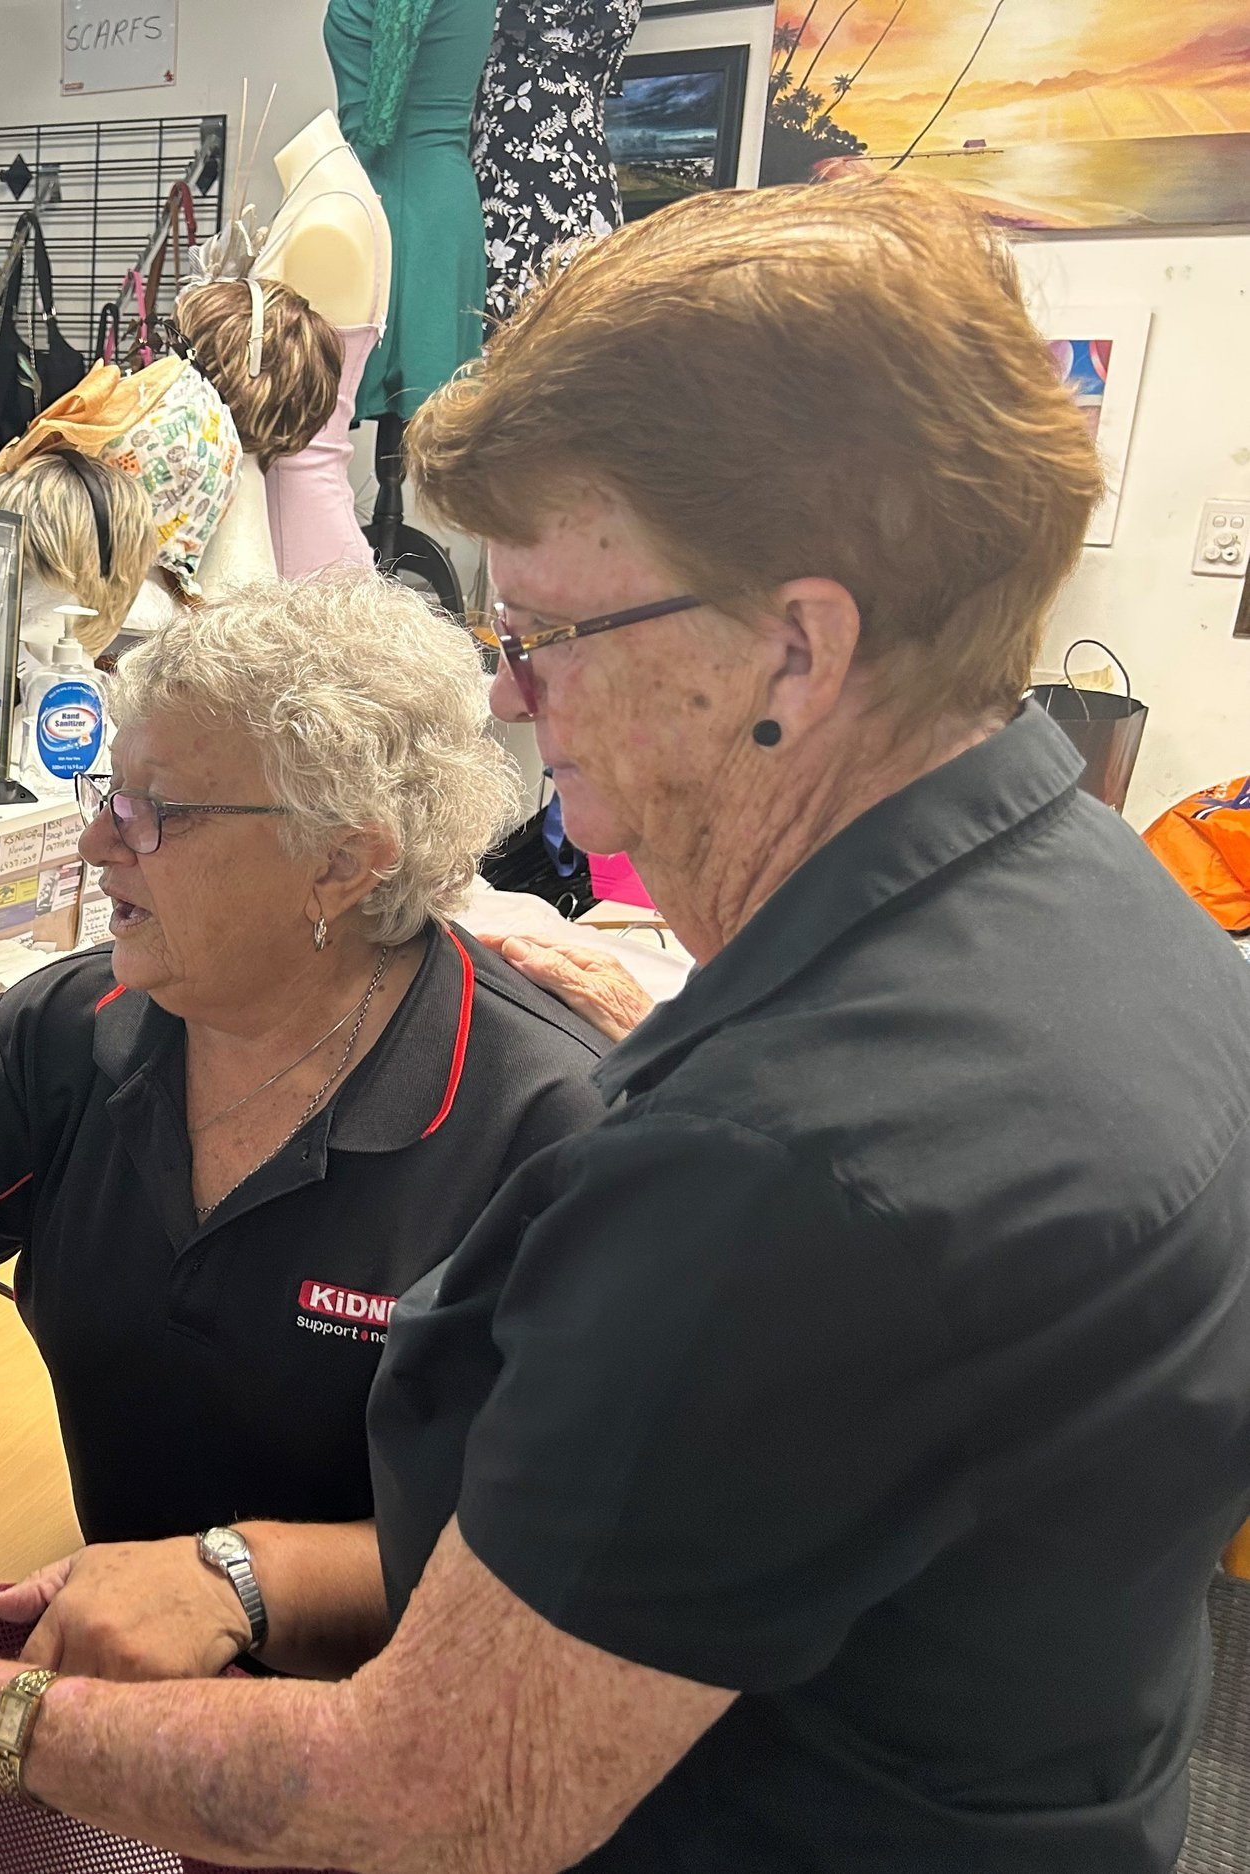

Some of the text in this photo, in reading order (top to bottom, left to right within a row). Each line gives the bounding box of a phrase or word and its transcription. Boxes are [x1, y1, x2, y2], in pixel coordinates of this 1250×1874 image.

[65, 16, 162, 51] SCARFS
[55, 720, 86, 728] Sanitizer
[296, 1315, 358, 1340] support
